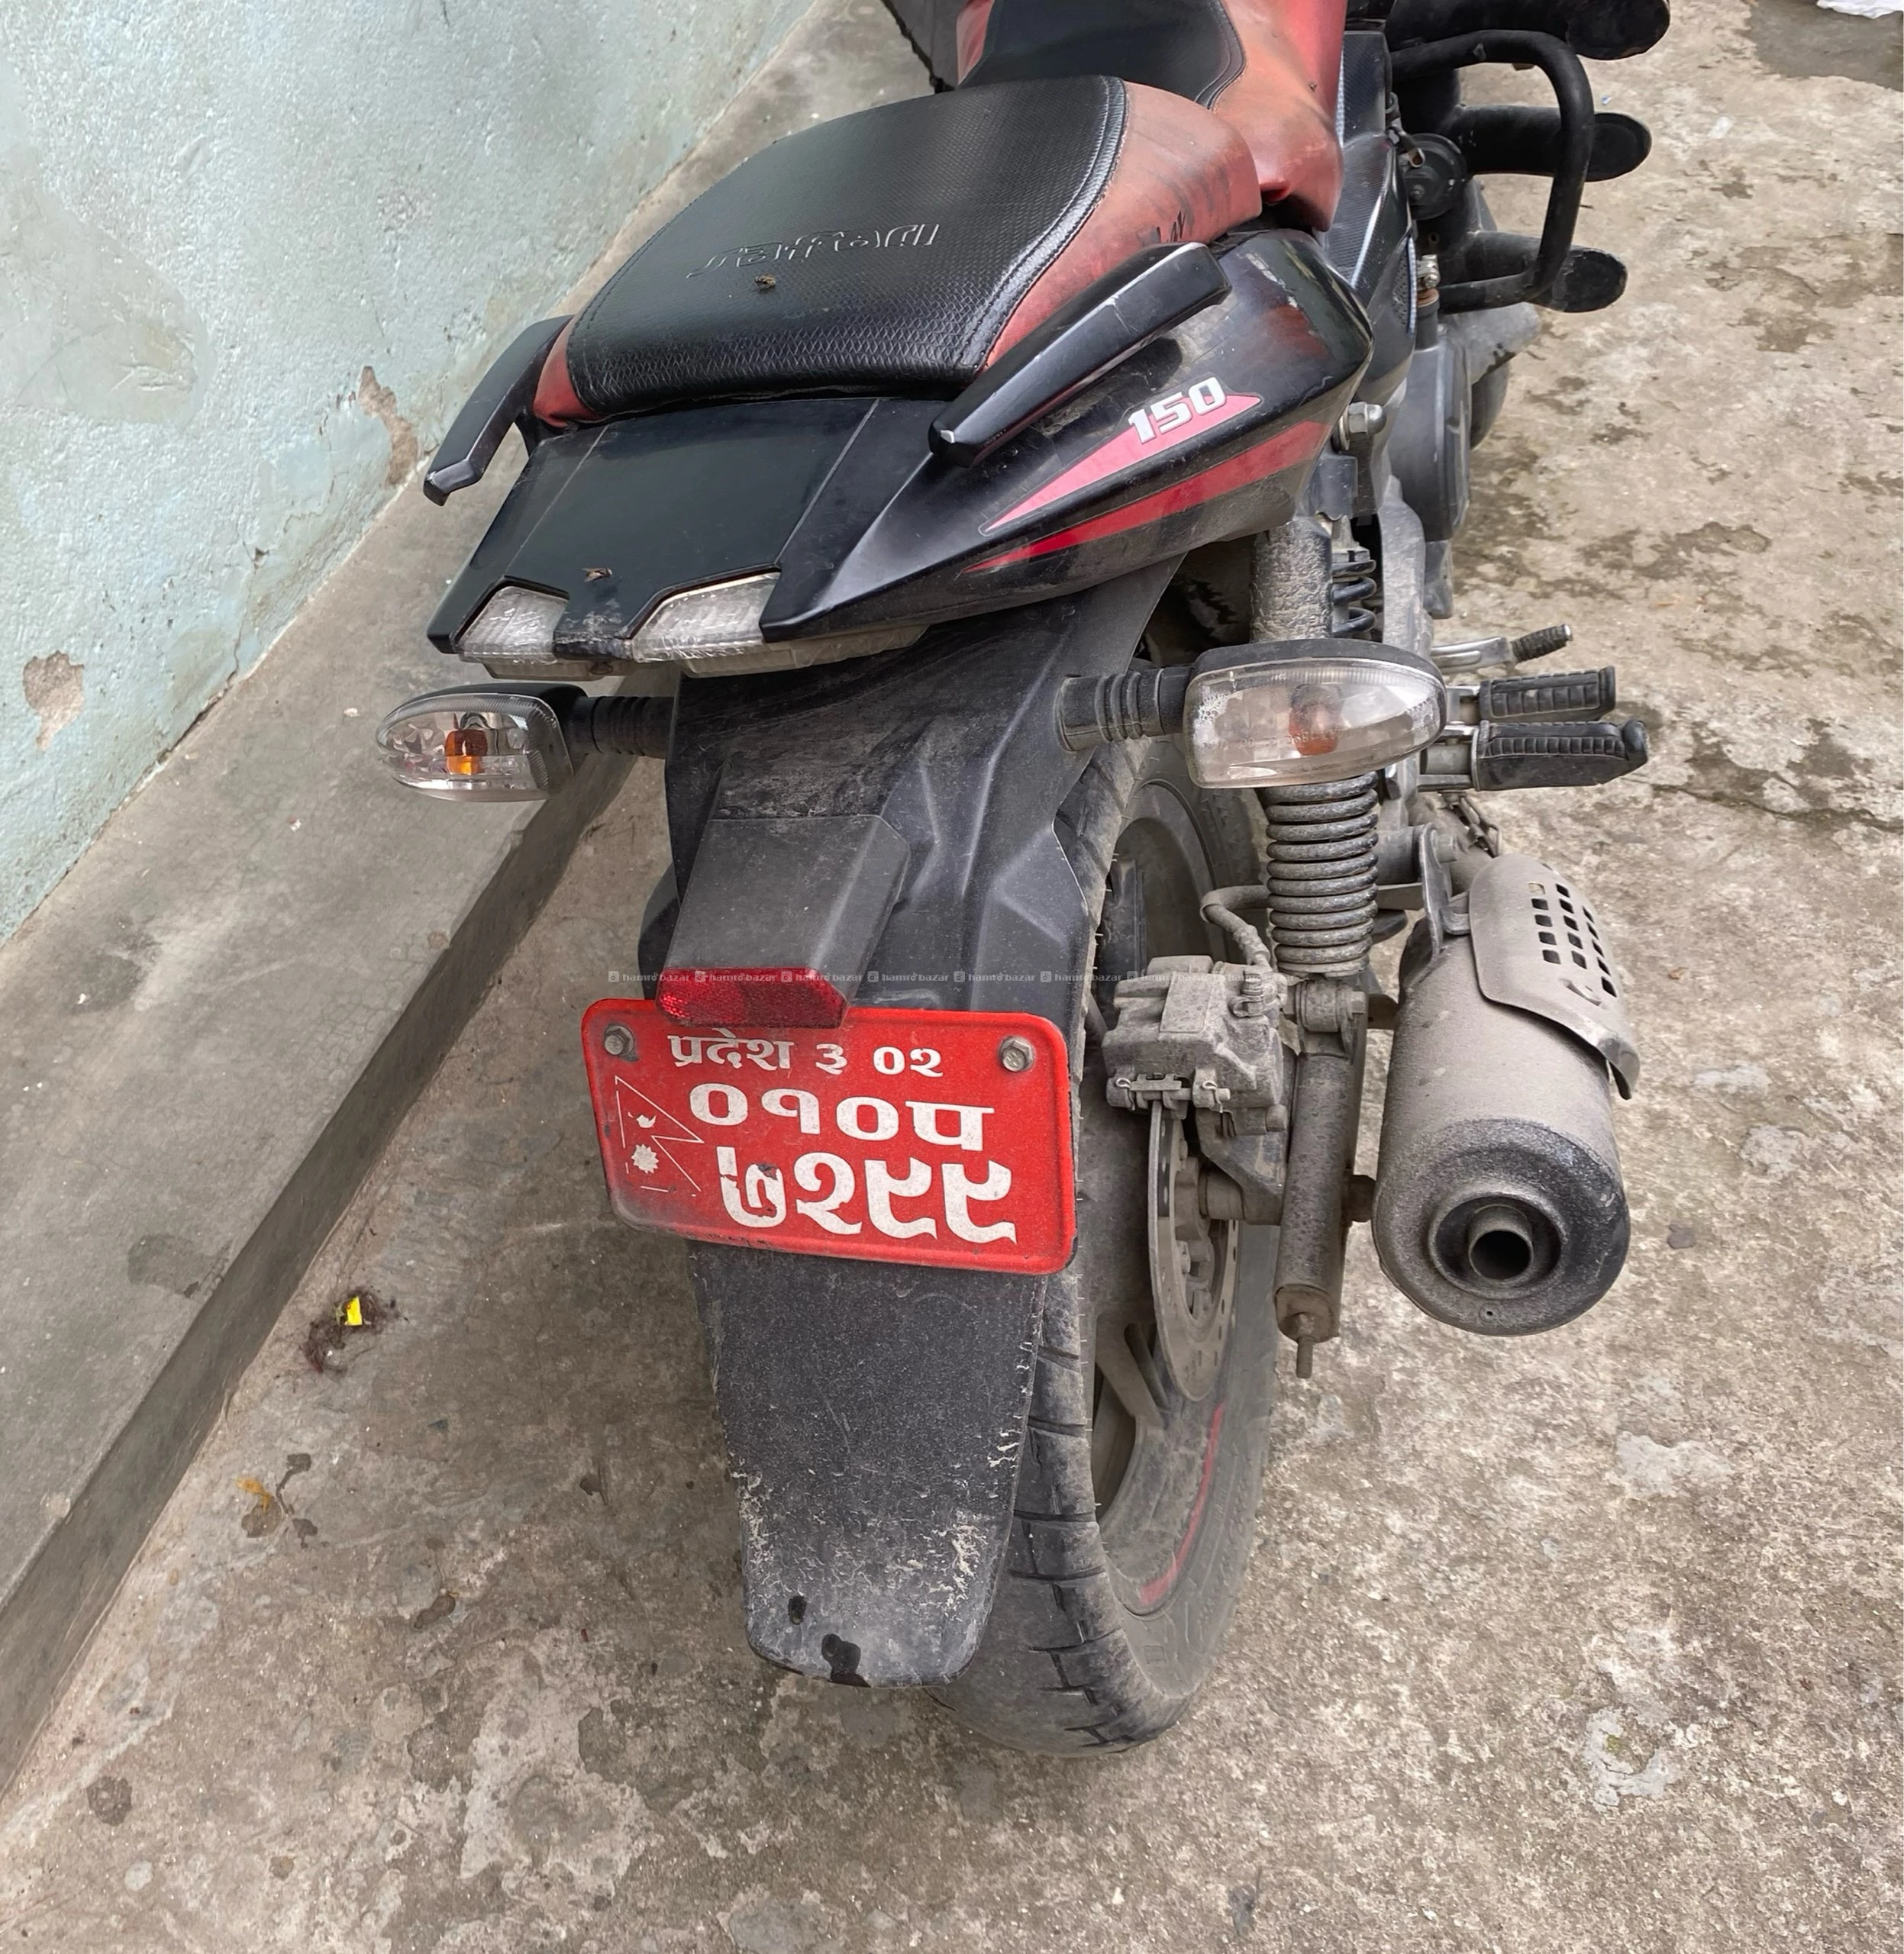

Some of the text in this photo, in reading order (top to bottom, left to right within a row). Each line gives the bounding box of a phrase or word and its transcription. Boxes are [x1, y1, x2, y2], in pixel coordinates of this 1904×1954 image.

[1128, 376, 1227, 445] 150
[667, 1028, 944, 1078] प्रदेश ३ ०२
[690, 1082, 995, 1151] ०१०प
[715, 1146, 1018, 1245] ७२९९
